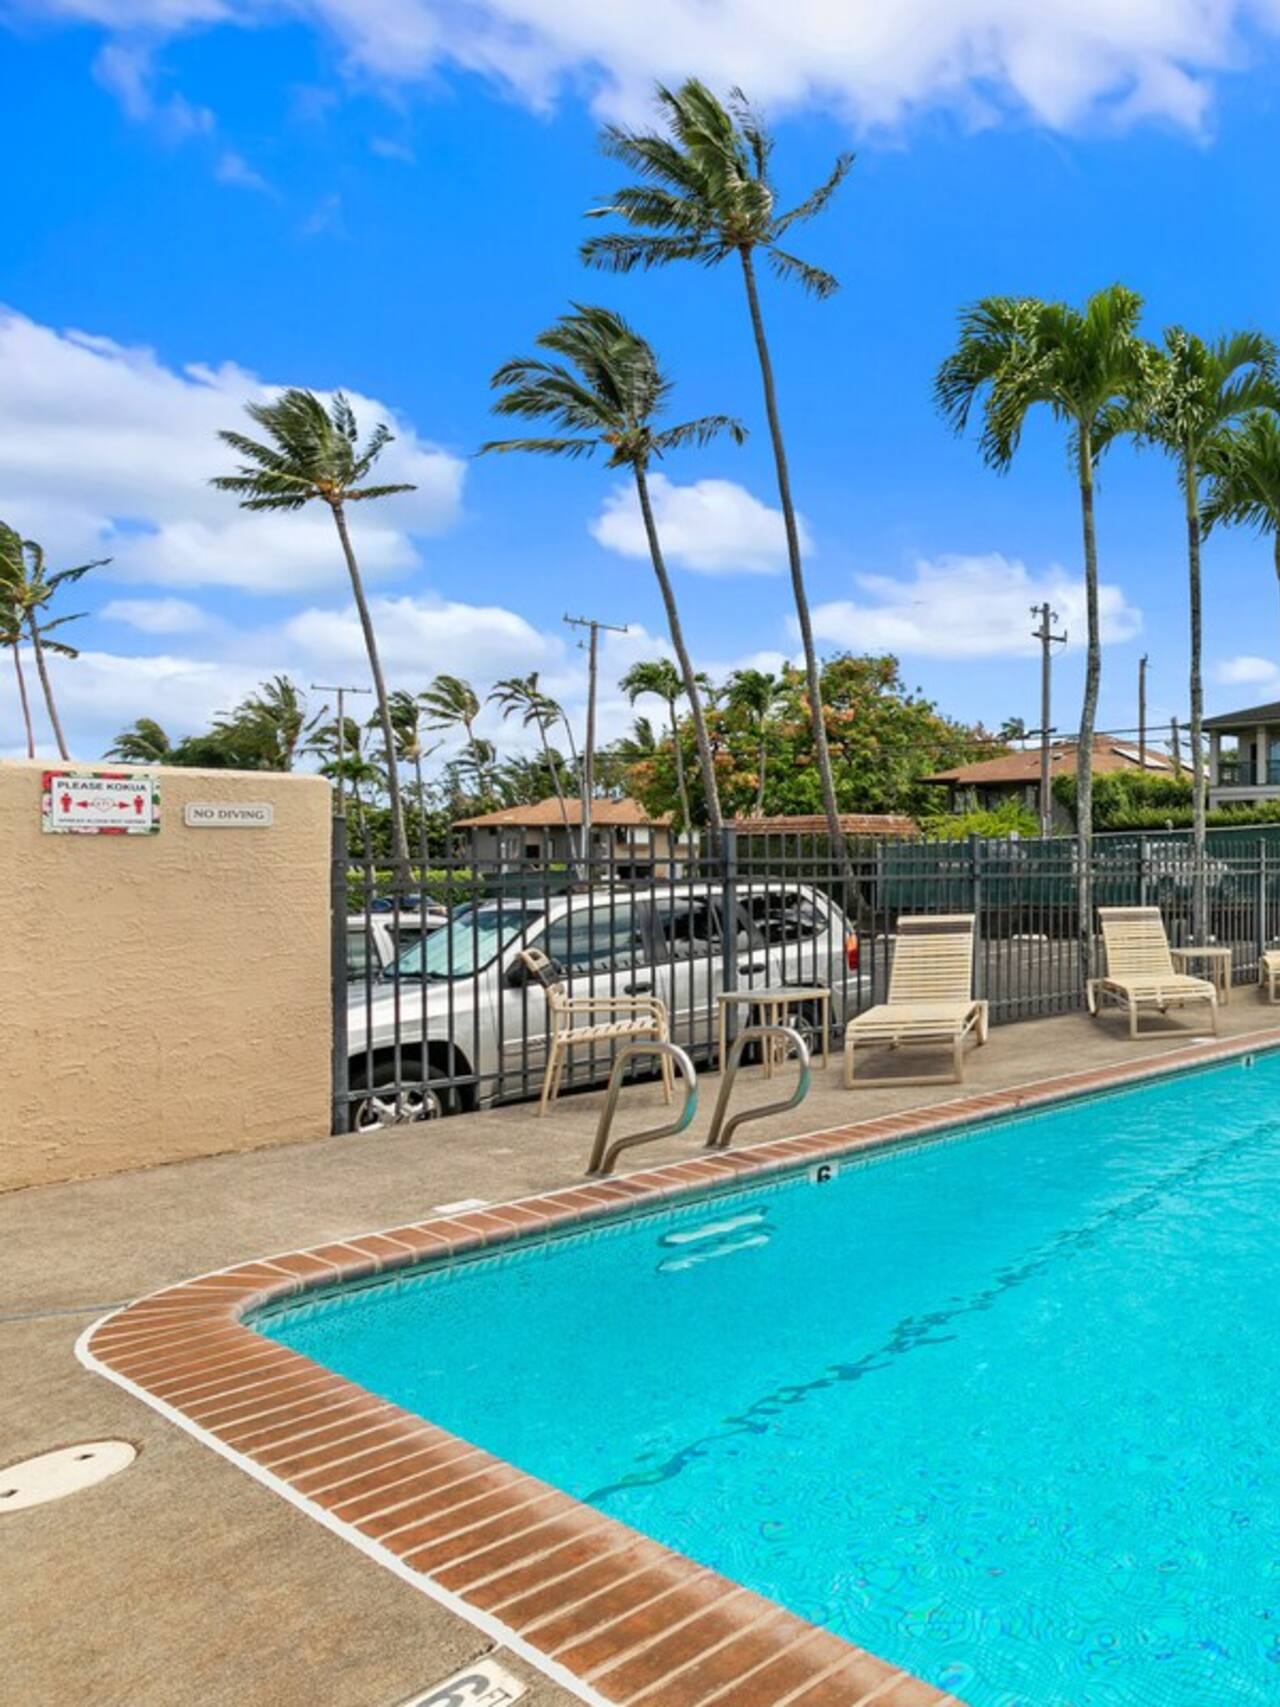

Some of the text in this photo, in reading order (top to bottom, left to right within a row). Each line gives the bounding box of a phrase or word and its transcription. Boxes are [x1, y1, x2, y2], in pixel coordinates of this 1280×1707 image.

[57, 780, 147, 791] PLEASE KOKUA
[193, 808, 265, 820] NO DIVING
